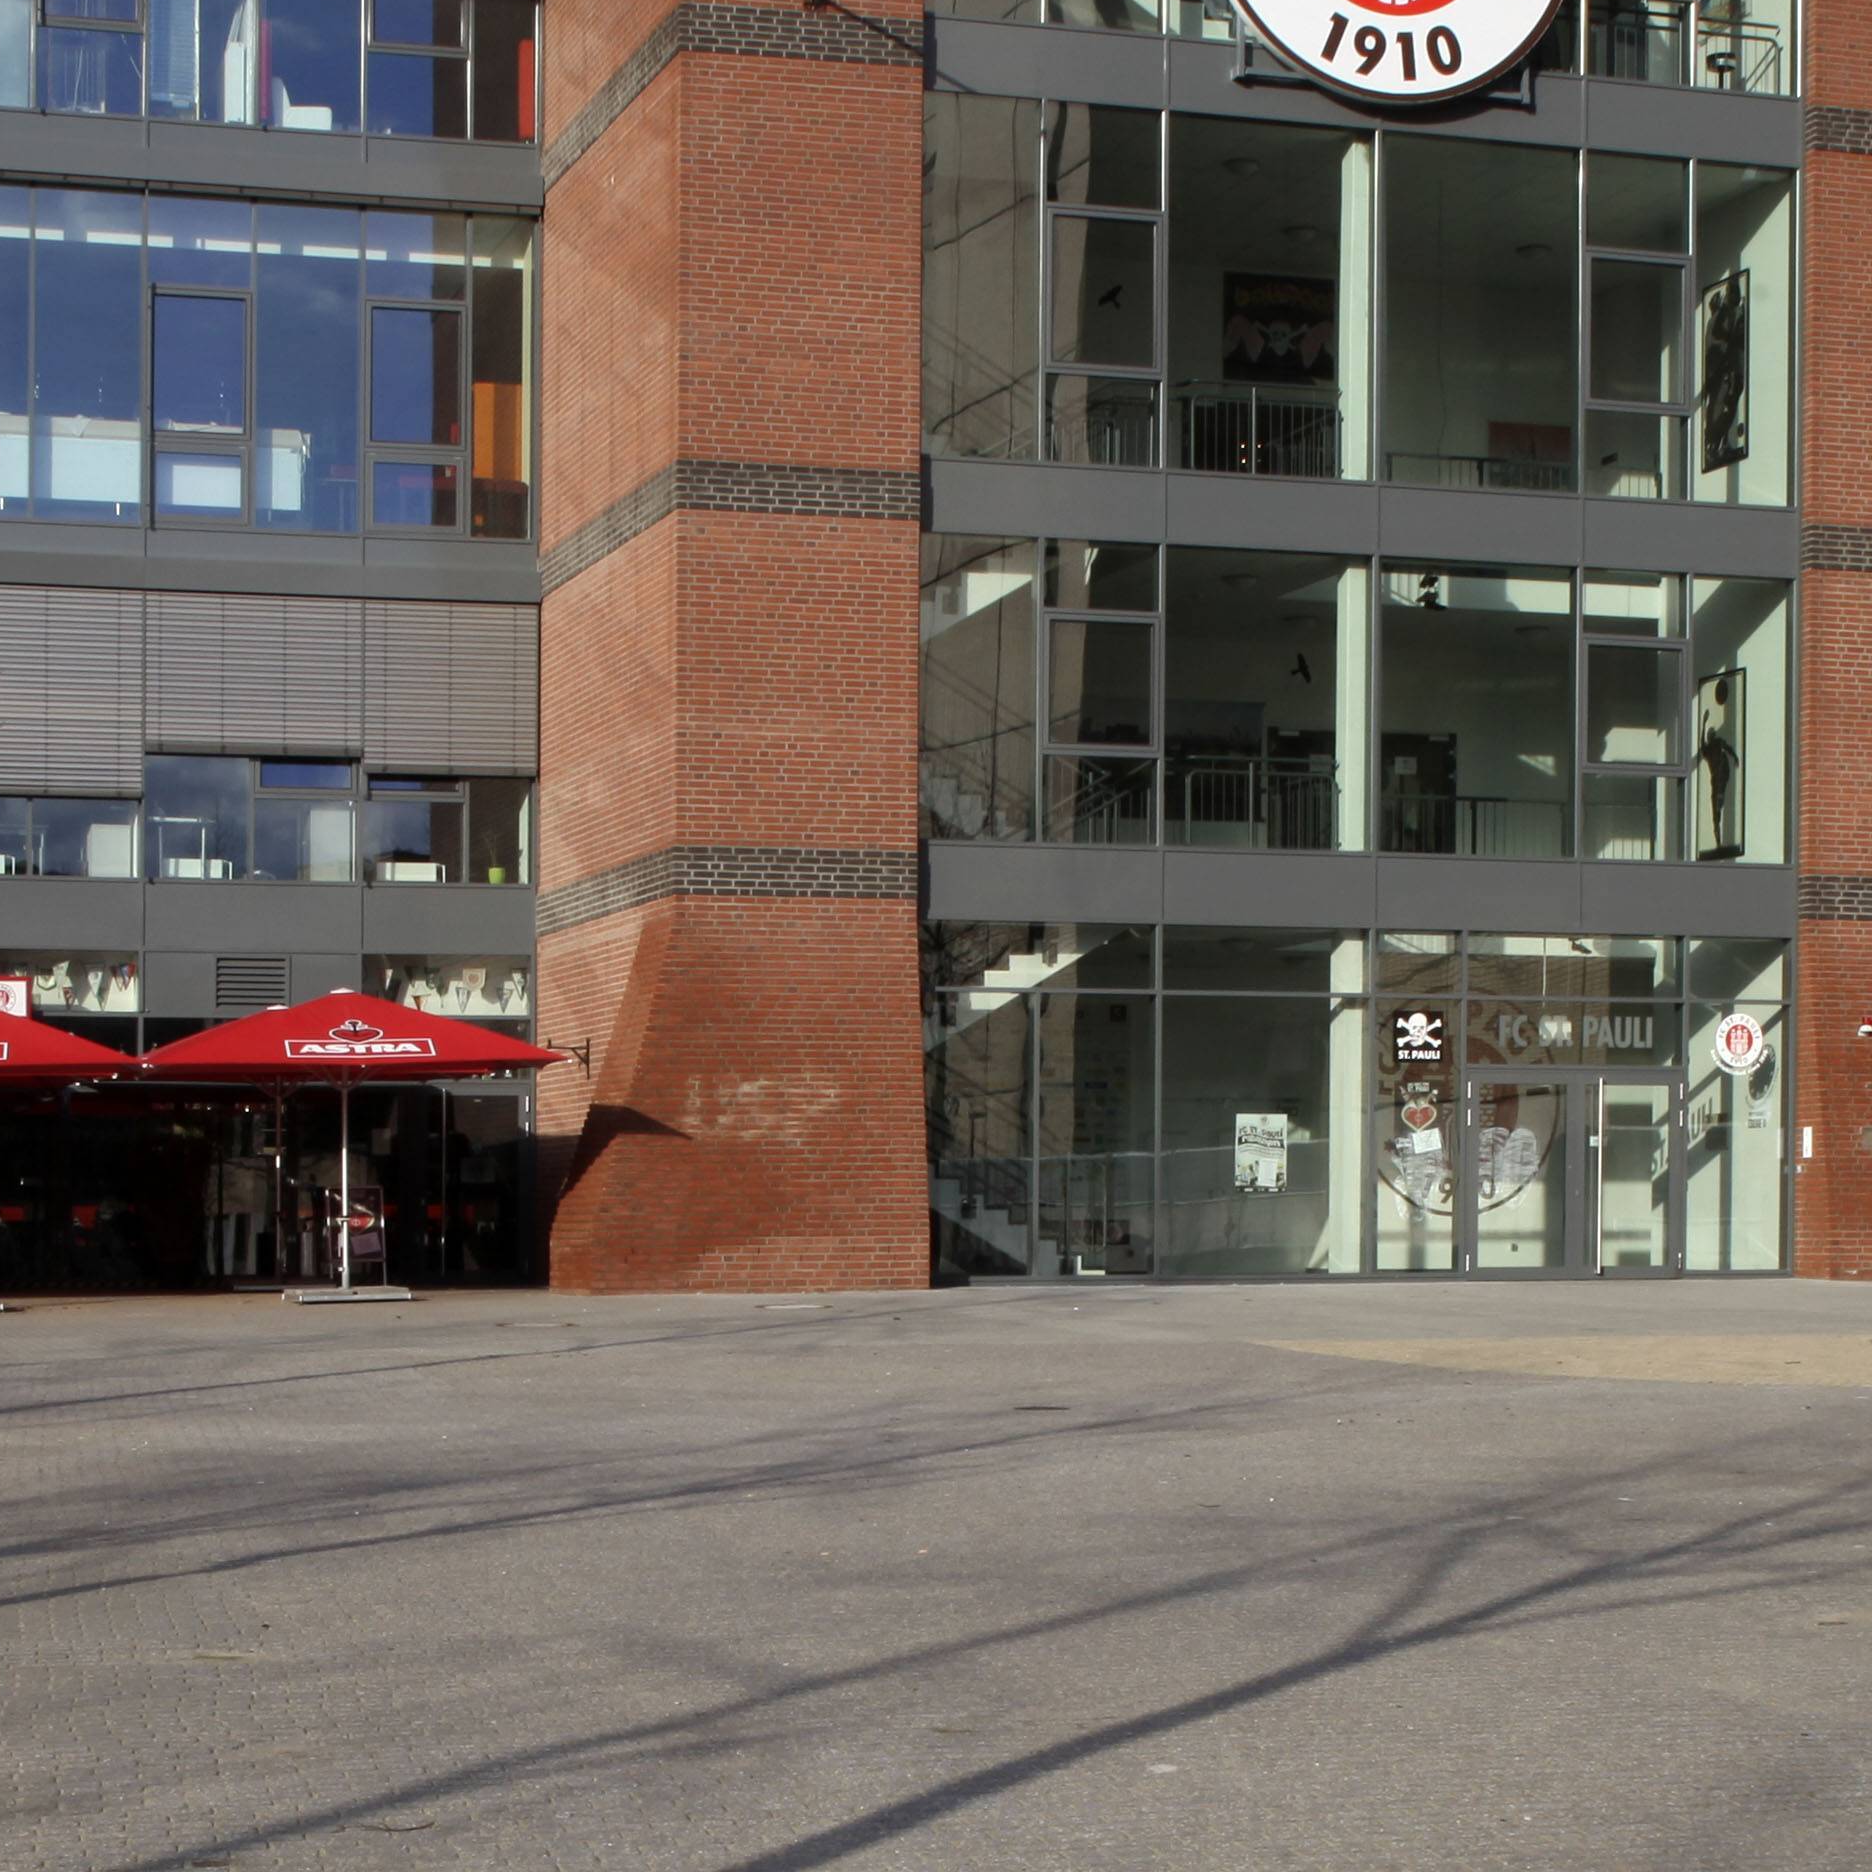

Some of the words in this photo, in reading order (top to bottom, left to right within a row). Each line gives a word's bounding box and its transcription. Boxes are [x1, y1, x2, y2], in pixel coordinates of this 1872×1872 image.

[1321, 12, 1462, 81] 1910
[1499, 1014, 1528, 1048] FC
[1583, 1016, 1653, 1049] PAULI
[299, 1043, 422, 1054] ASTRA
[1398, 1050, 1411, 1060] ST.
[1412, 1050, 1441, 1060] PAULI
